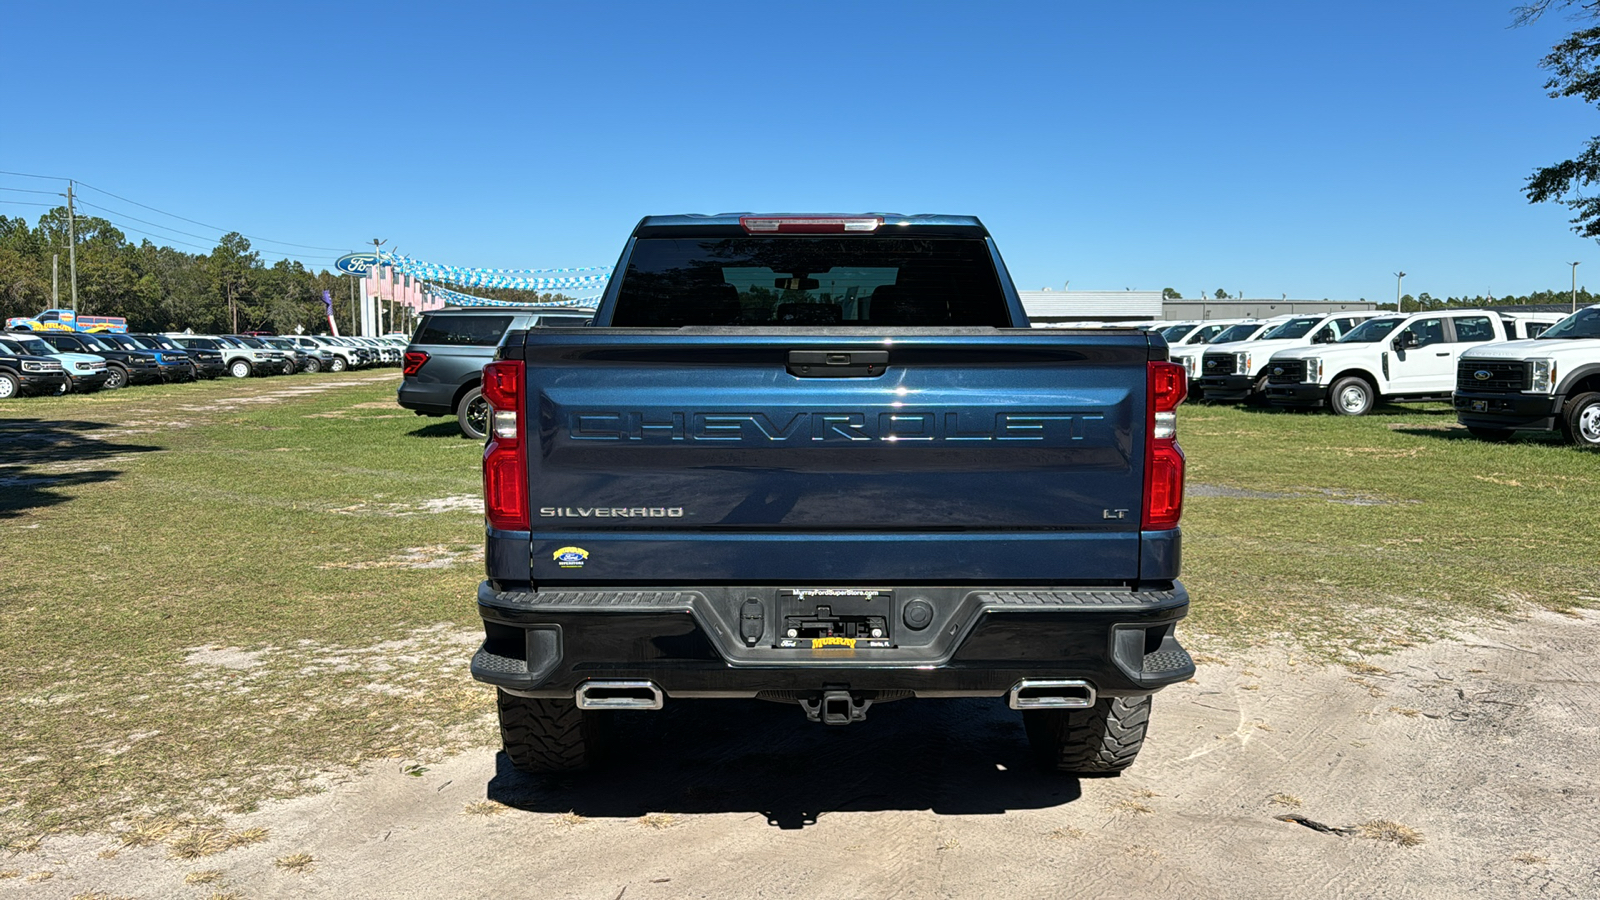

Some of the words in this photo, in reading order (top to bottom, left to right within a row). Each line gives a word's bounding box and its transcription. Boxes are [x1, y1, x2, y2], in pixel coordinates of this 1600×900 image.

[570, 412, 1104, 440] CHEVROLET
[540, 507, 684, 518] SILVERADO
[1103, 508, 1129, 519] LT
[812, 637, 856, 649] MURRAY
